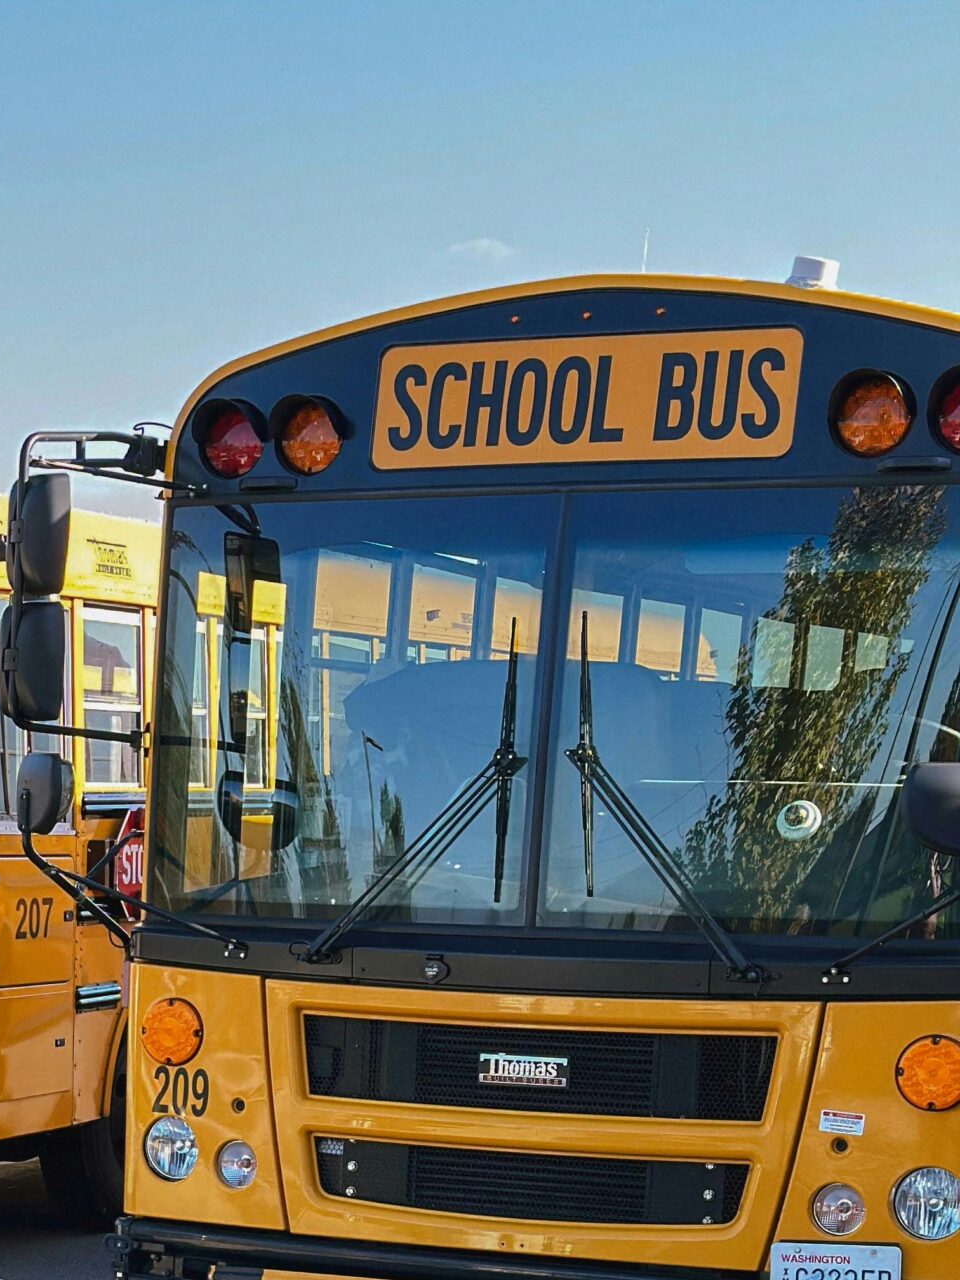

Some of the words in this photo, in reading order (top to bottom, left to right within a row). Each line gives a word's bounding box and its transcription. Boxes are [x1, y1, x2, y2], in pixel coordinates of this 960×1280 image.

[388, 356, 624, 451] SCHOOL
[652, 347, 786, 440] BUS
[15, 897, 54, 940] 207
[480, 1053, 568, 1078] Thomas
[152, 1065, 209, 1117] 209
[781, 1254, 851, 1264] WASHINGTON
